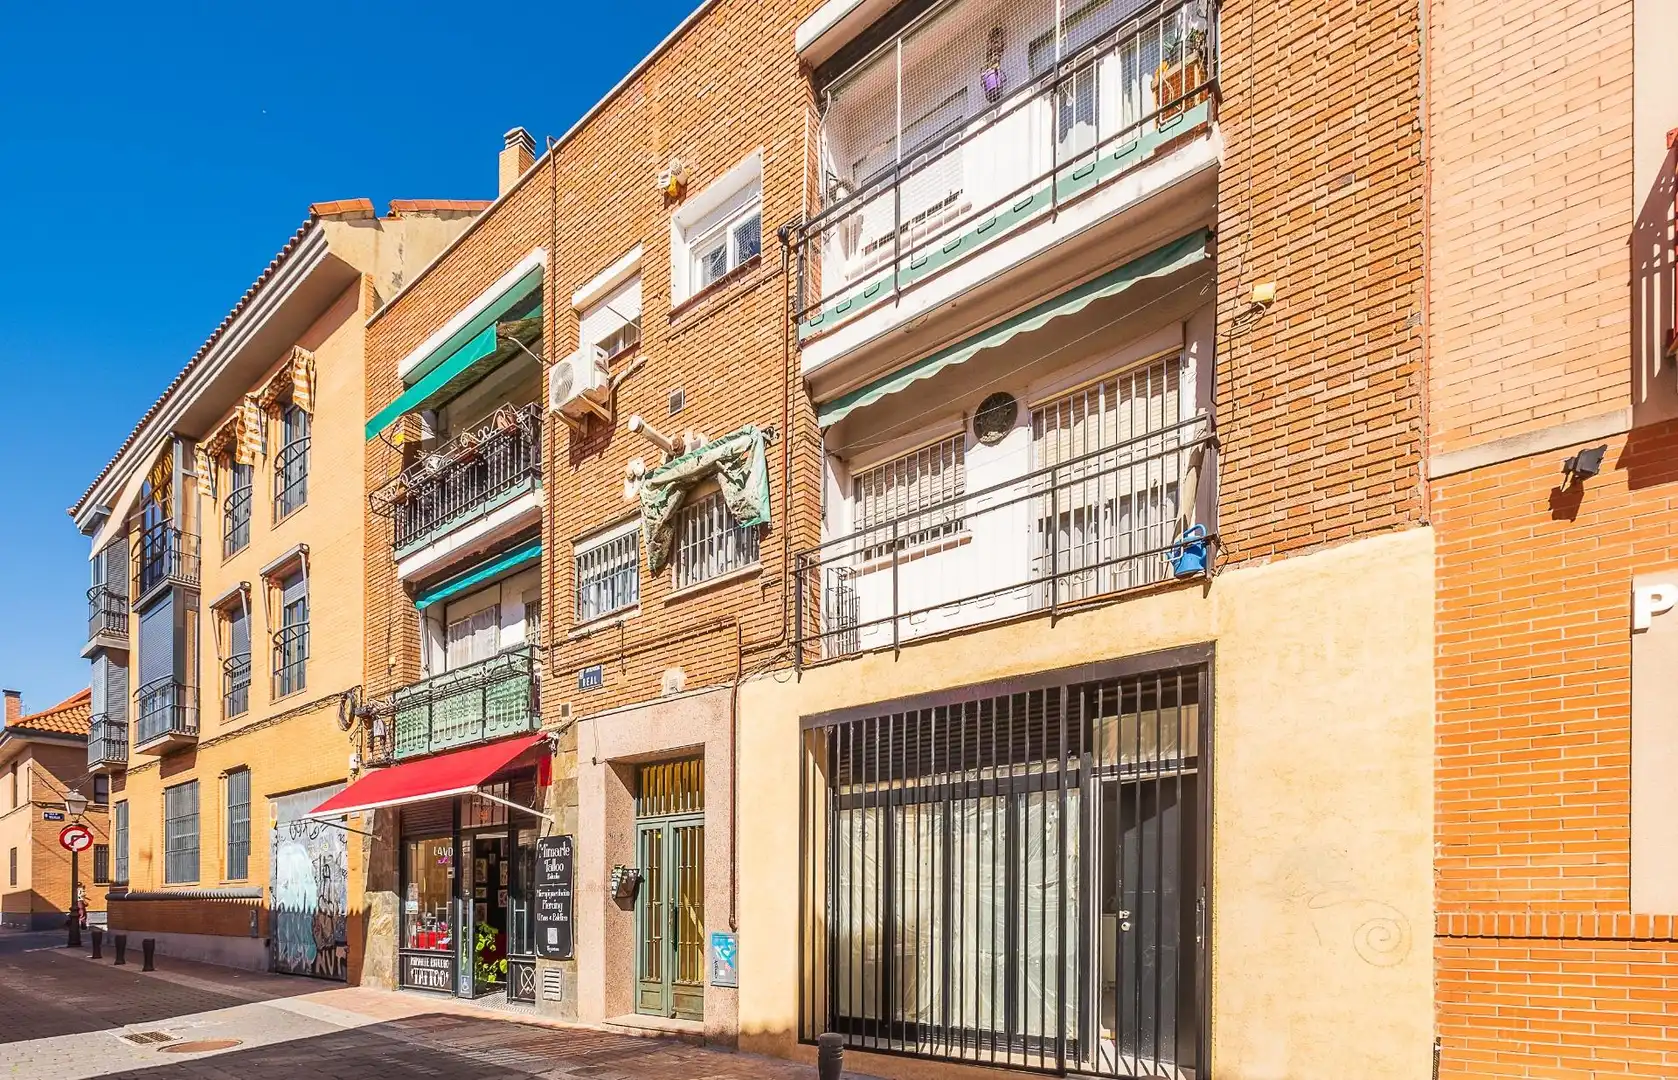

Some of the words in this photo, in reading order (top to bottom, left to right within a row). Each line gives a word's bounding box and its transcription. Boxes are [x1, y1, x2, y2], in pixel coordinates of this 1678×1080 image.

[583, 676, 597, 687] REAL
[542, 899, 563, 912] Piercing
[413, 967, 446, 987] TATTOO
